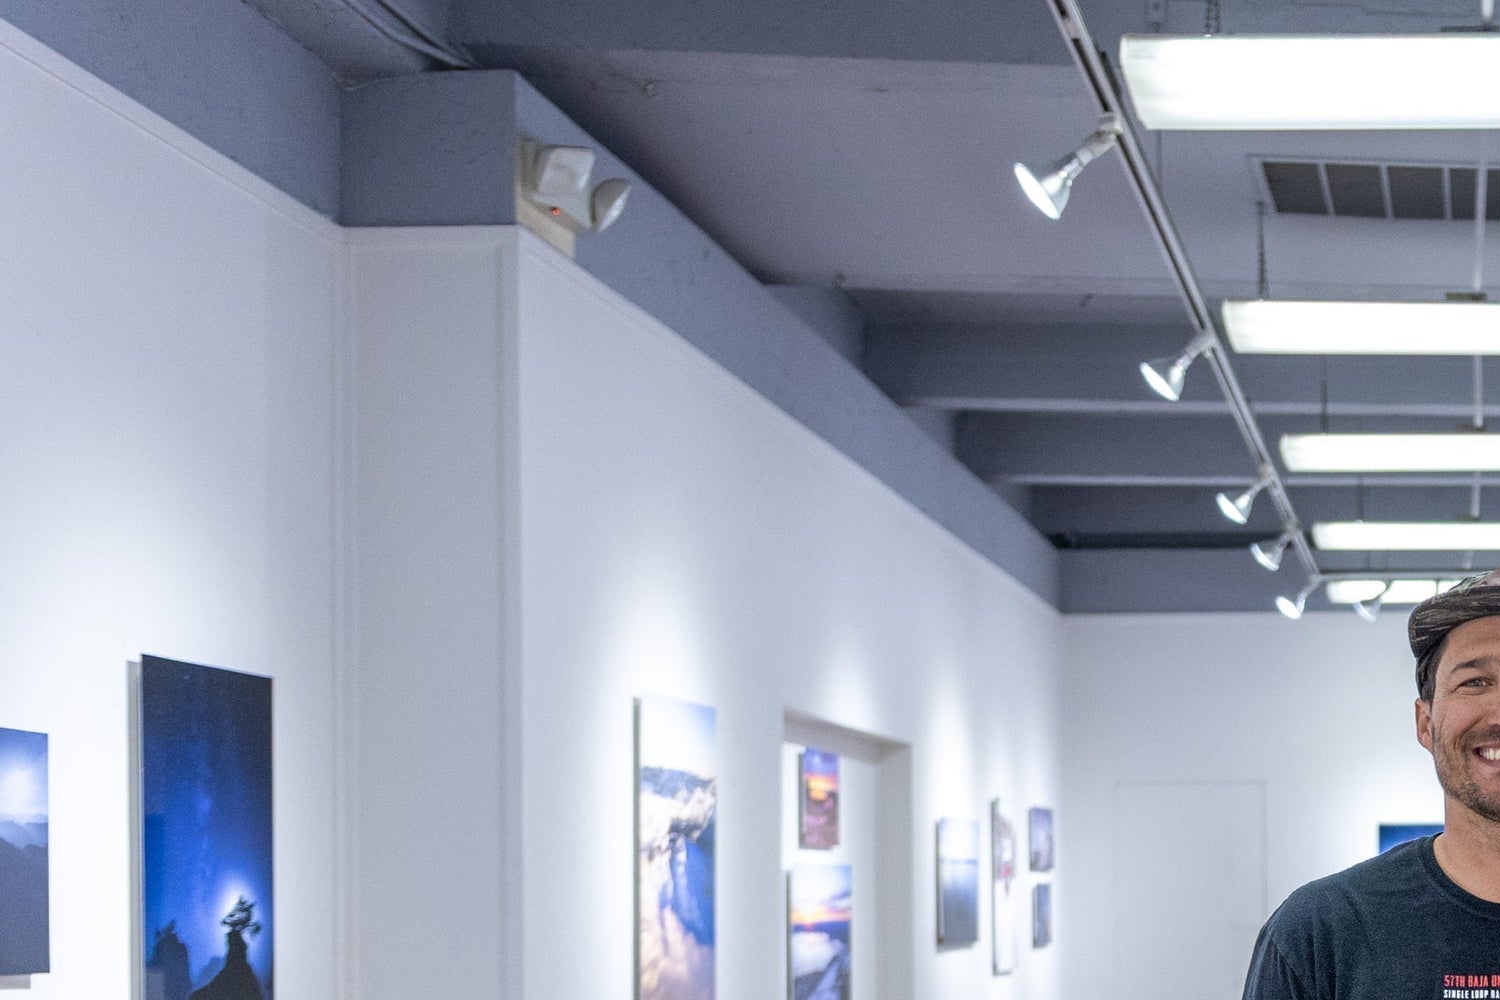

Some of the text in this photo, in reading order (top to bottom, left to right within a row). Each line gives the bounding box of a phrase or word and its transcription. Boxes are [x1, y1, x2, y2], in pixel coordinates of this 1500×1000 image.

[1444, 975, 1466, 988] 57TH
[1468, 975, 1489, 988] BAJA
[1443, 989, 1469, 999] SINGLE
[1471, 989, 1489, 999] LOOP
